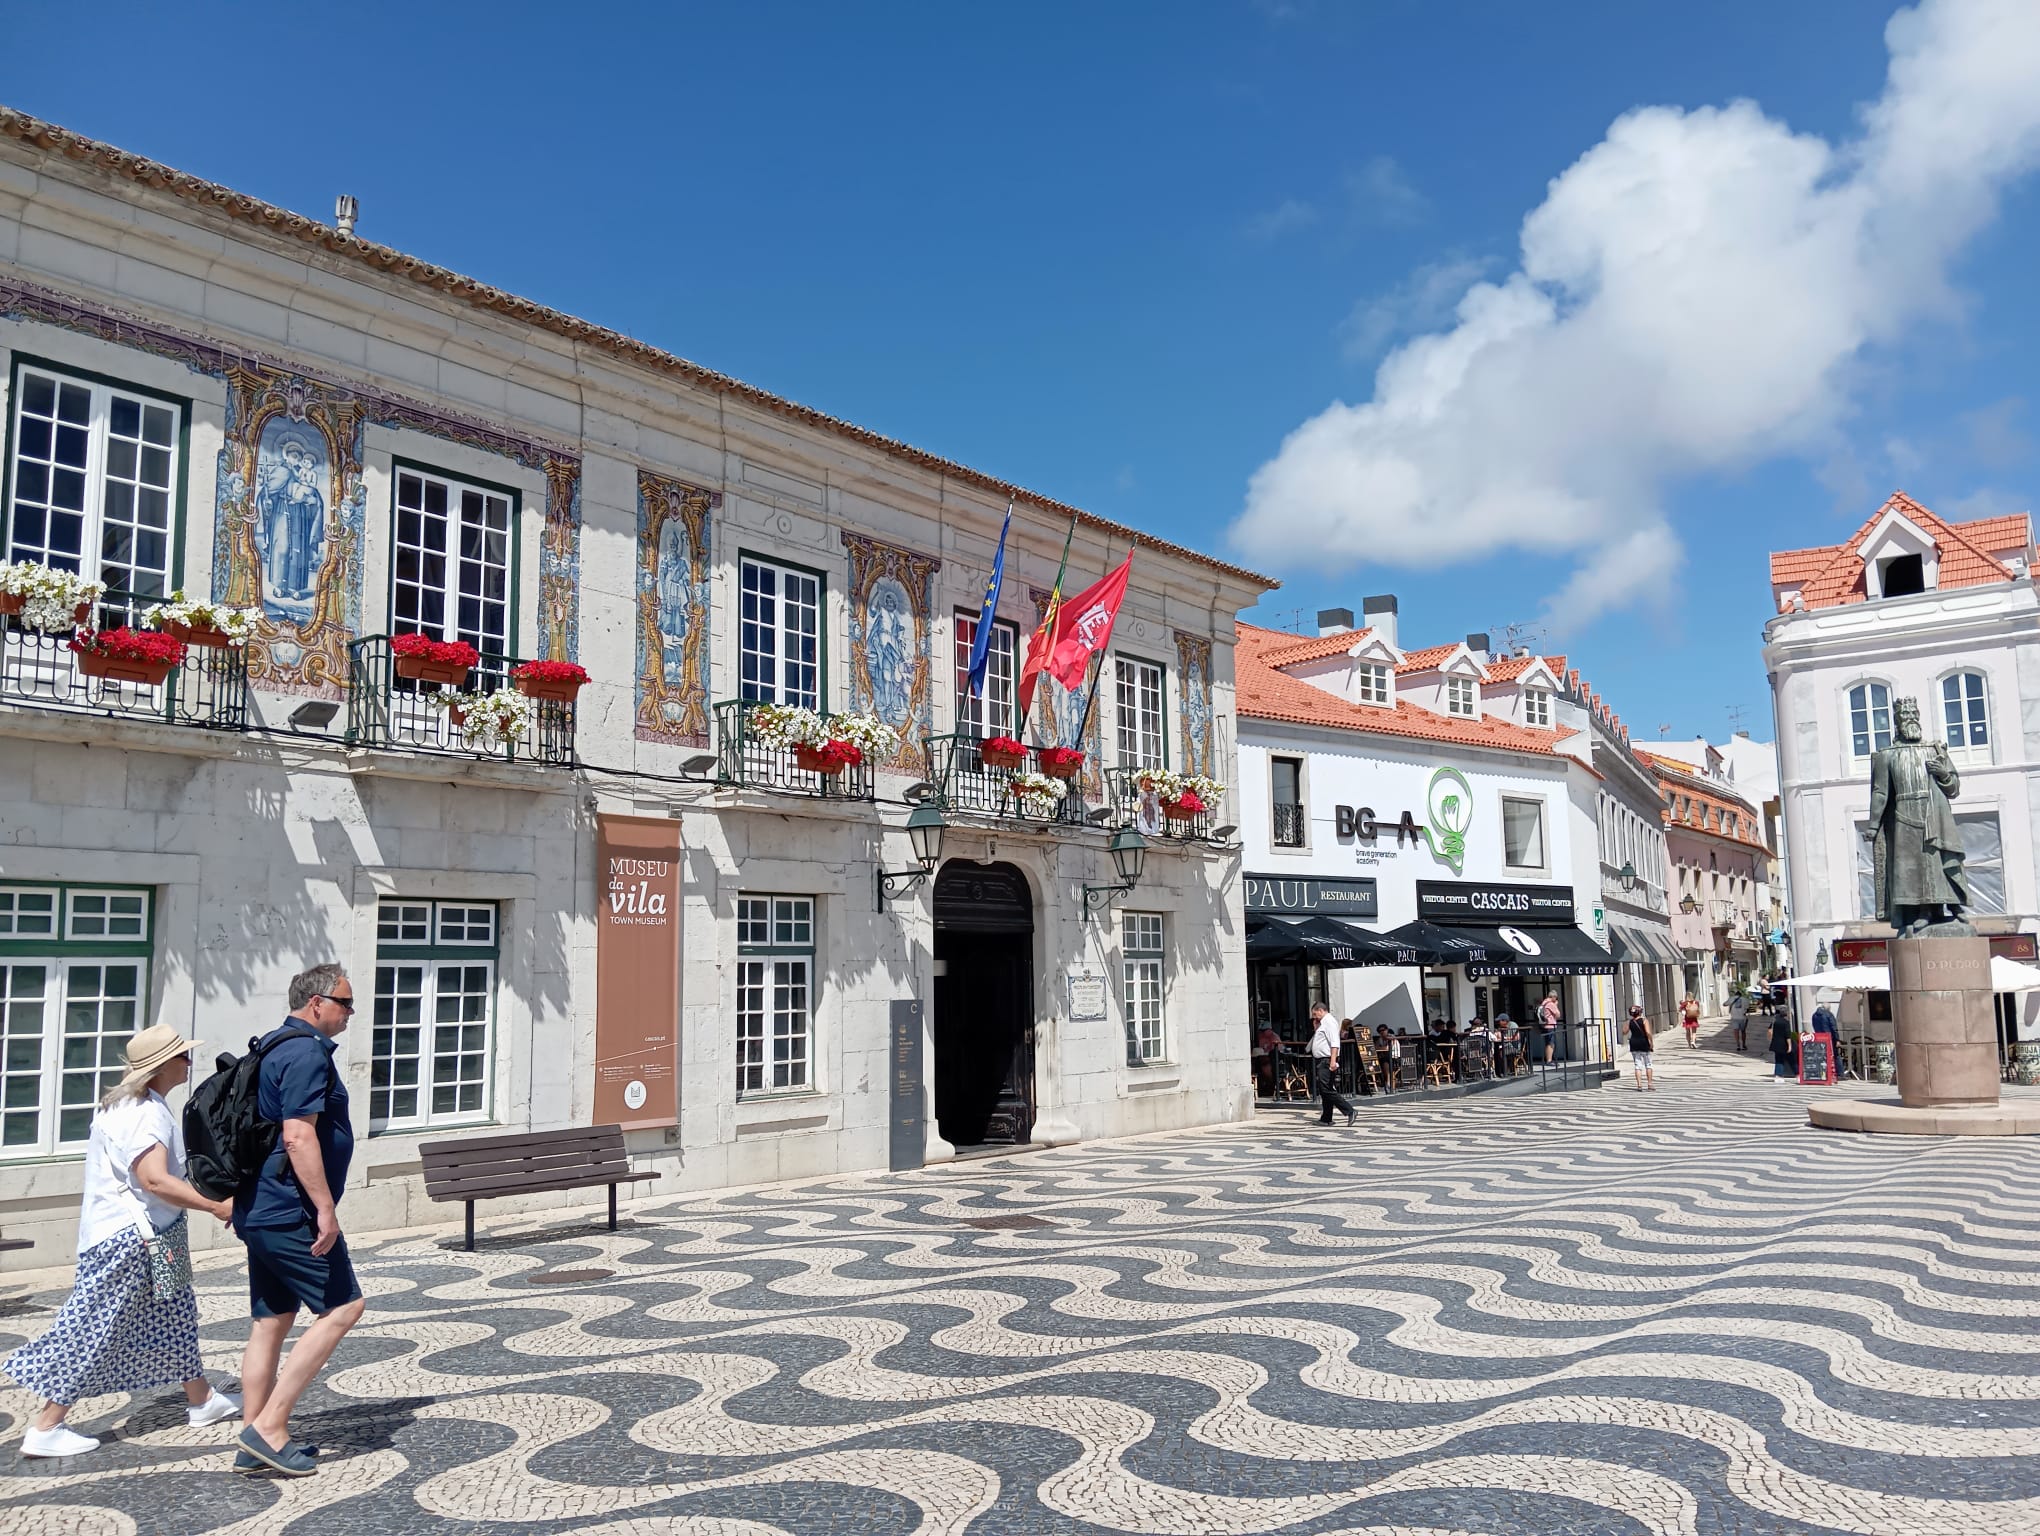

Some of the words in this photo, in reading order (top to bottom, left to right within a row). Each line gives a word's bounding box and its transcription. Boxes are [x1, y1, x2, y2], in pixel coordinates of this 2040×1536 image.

[1356, 849, 1370, 857] brave
[1371, 850, 1397, 859] generation
[609, 858, 668, 877] MUSEU
[1356, 858, 1379, 866] academy
[609, 876, 624, 890] da
[609, 881, 667, 915] vila
[1243, 880, 1318, 908] PAUL
[1321, 891, 1371, 901] RESTAURANT
[1422, 895, 1445, 903] VISITOR
[1445, 896, 1468, 904] CENTER
[1471, 892, 1529, 910] CASCAIS
[1531, 899, 1551, 907] VISITOR
[1552, 899, 1572, 907] CENTER
[635, 917, 667, 925] MUSEUM
[1332, 947, 1355, 961] PAUL
[1397, 949, 1417, 962] PAUL
[1469, 949, 1488, 961] PAUL
[1472, 967, 1518, 975] CASCAIS
[1527, 967, 1570, 975] VISITOR
[1578, 966, 1615, 975] CENTER
